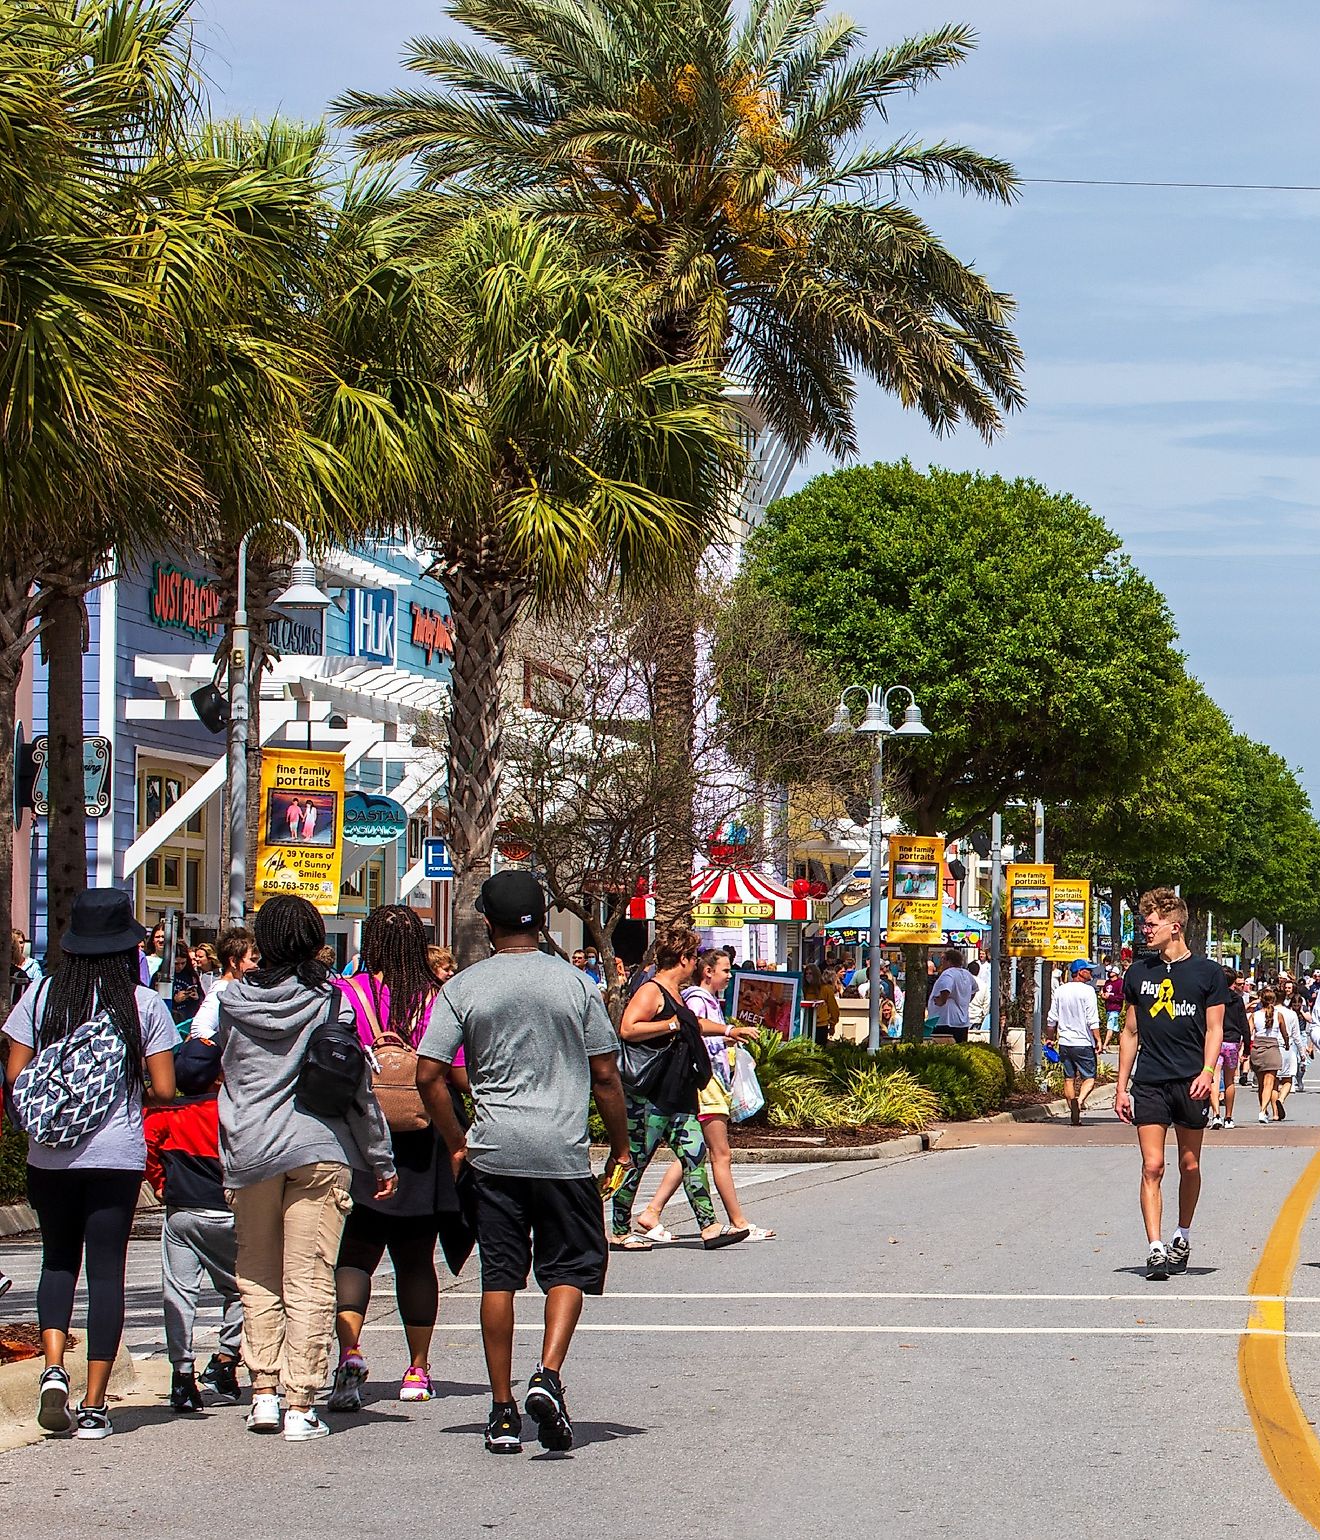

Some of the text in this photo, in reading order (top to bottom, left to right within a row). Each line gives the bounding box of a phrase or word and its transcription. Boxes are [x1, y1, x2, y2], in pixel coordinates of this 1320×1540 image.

[155, 567, 181, 622] JUST
[277, 765, 331, 778] fine family
[276, 776, 331, 787] portraits
[345, 809, 404, 823] OASTAL
[344, 825, 398, 837] CASUALS
[287, 850, 297, 858] 39
[299, 850, 323, 859] Years
[293, 860, 331, 871] of Sunny
[298, 870, 327, 878] Smiles
[263, 880, 319, 891] 850-763-5795
[693, 905, 770, 915] LIAN ICE
[1140, 980, 1161, 999] Play
[739, 1010, 765, 1025] MEET
